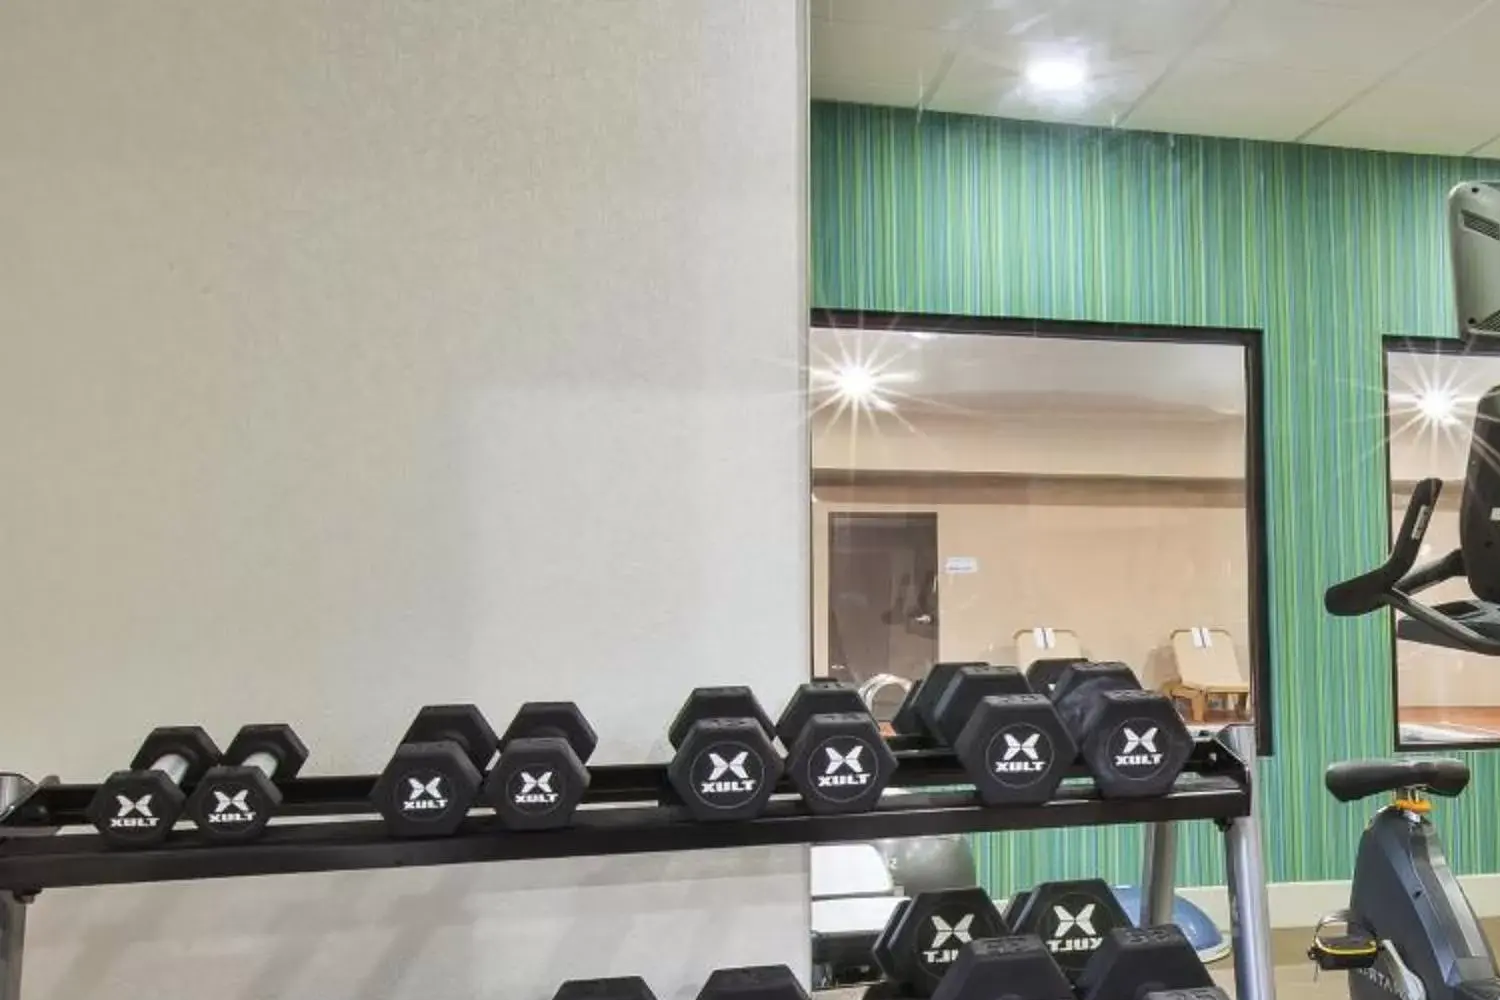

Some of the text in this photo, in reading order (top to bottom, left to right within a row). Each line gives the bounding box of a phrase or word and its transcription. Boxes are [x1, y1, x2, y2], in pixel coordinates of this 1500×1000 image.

[1115, 754, 1163, 765] XULT
[995, 761, 1046, 773] XULT
[818, 773, 871, 787] XULT
[701, 779, 756, 793] XULT
[515, 792, 559, 803] XULT
[403, 800, 448, 810] XULT
[111, 817, 160, 828] XULT
[208, 811, 257, 823] XULT
